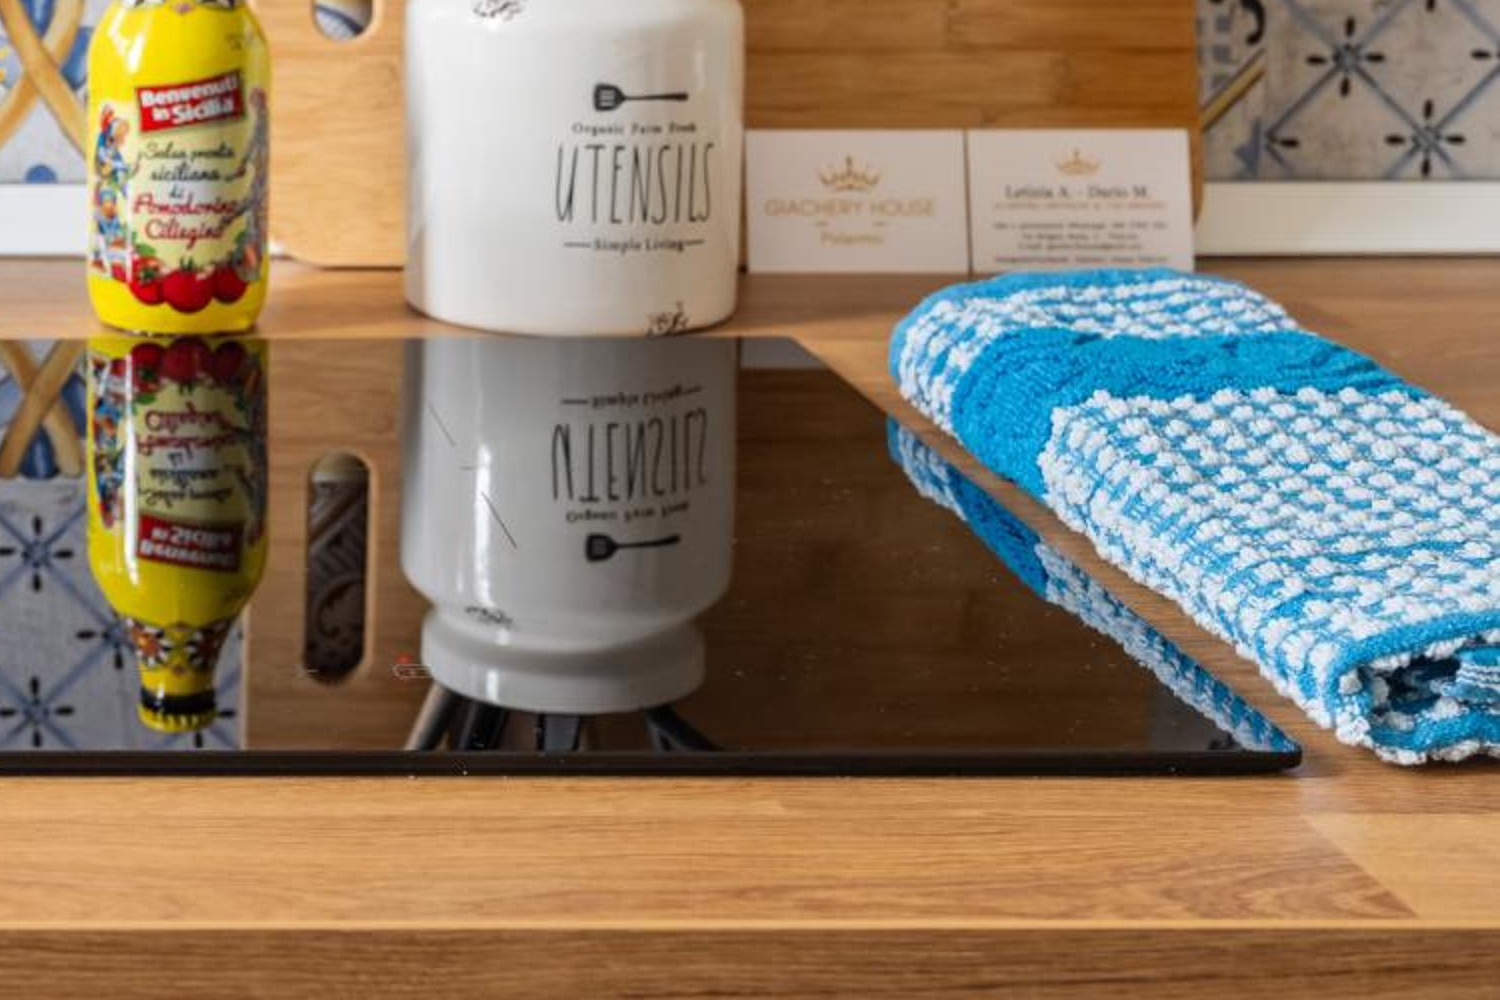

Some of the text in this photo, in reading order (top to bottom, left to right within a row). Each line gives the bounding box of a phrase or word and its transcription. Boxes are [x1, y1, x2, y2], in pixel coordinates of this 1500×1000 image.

[140, 74, 238, 108] Benvenuti
[152, 96, 234, 125] in Sicilia
[571, 120, 697, 137] Organic Farm Fresh
[151, 161, 220, 181] siciliana
[555, 142, 715, 225] UTENSILS
[764, 198, 934, 217] GIACHERY HOUSE
[593, 237, 686, 255] Simple Living
